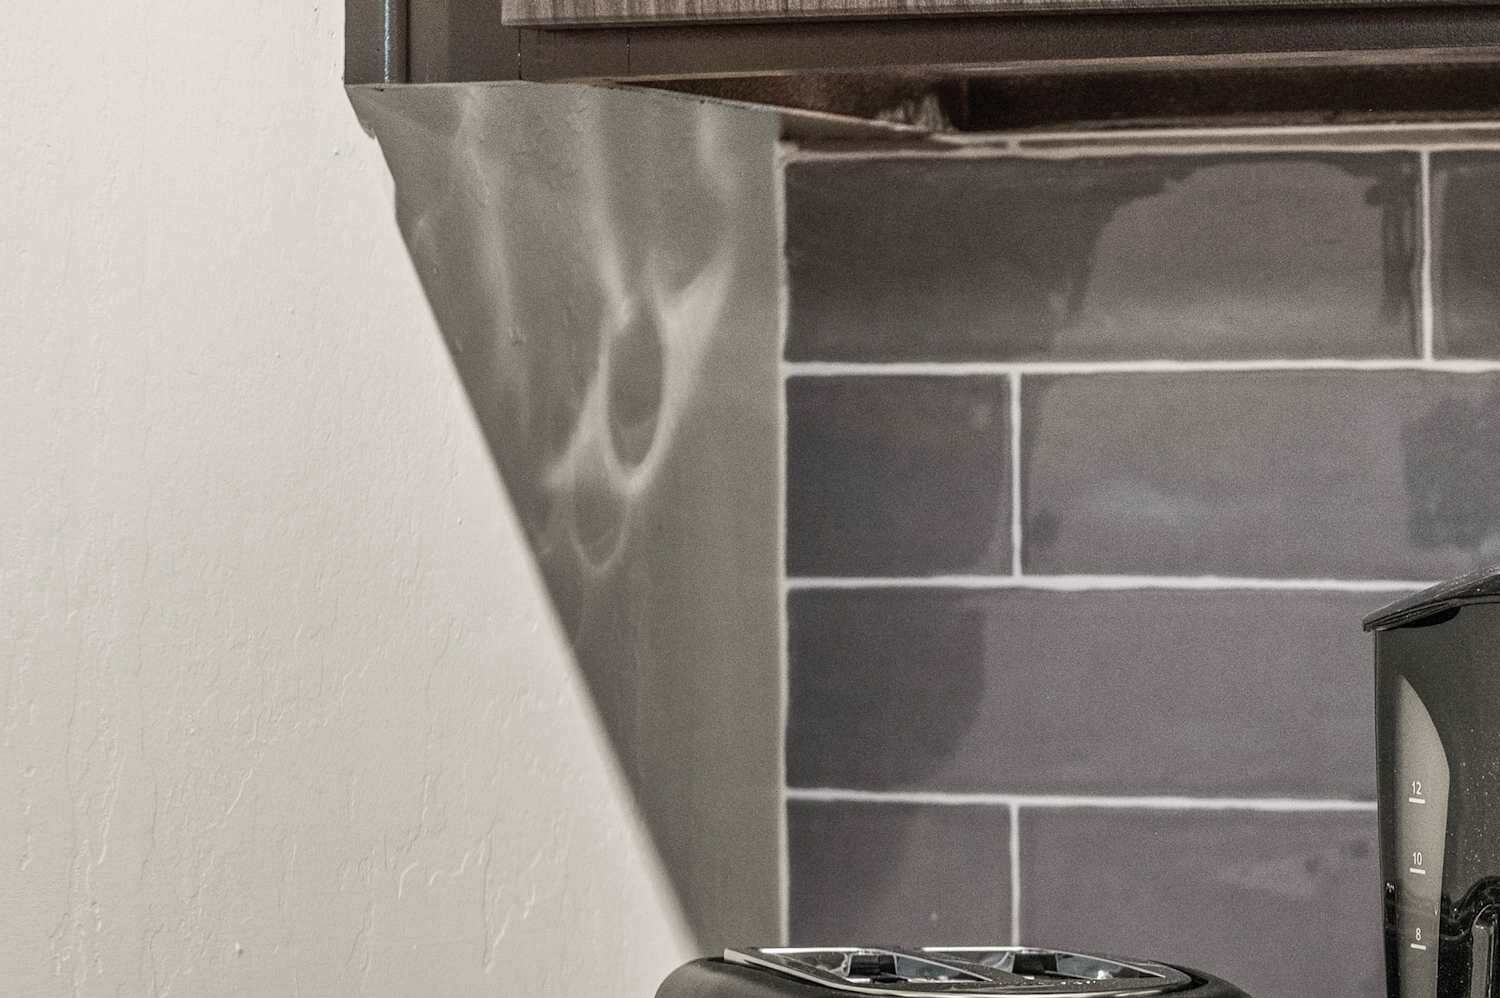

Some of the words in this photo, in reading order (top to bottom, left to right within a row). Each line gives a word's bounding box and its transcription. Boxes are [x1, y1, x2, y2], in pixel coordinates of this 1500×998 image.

[1411, 780, 1423, 796] 12
[1412, 851, 1423, 868] 10
[1415, 926, 1422, 942] 8
